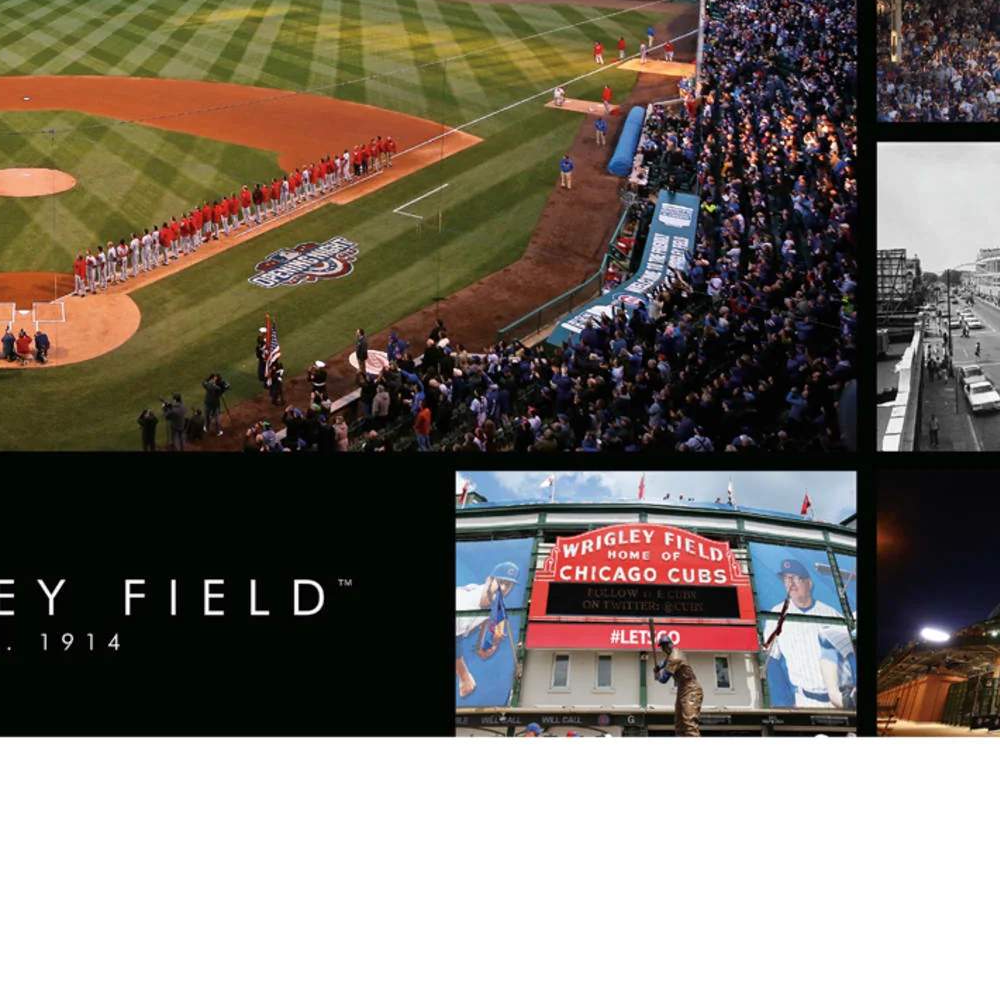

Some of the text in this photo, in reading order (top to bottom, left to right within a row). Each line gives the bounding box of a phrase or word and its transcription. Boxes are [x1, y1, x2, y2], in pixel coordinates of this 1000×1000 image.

[563, 529, 724, 562] WRIGLEY FIELD
[607, 550, 681, 561] HOME OF
[559, 566, 727, 584] CHICAGO CUBS
[587, 588, 638, 599] FOLLOW
[582, 601, 599, 609] ON
